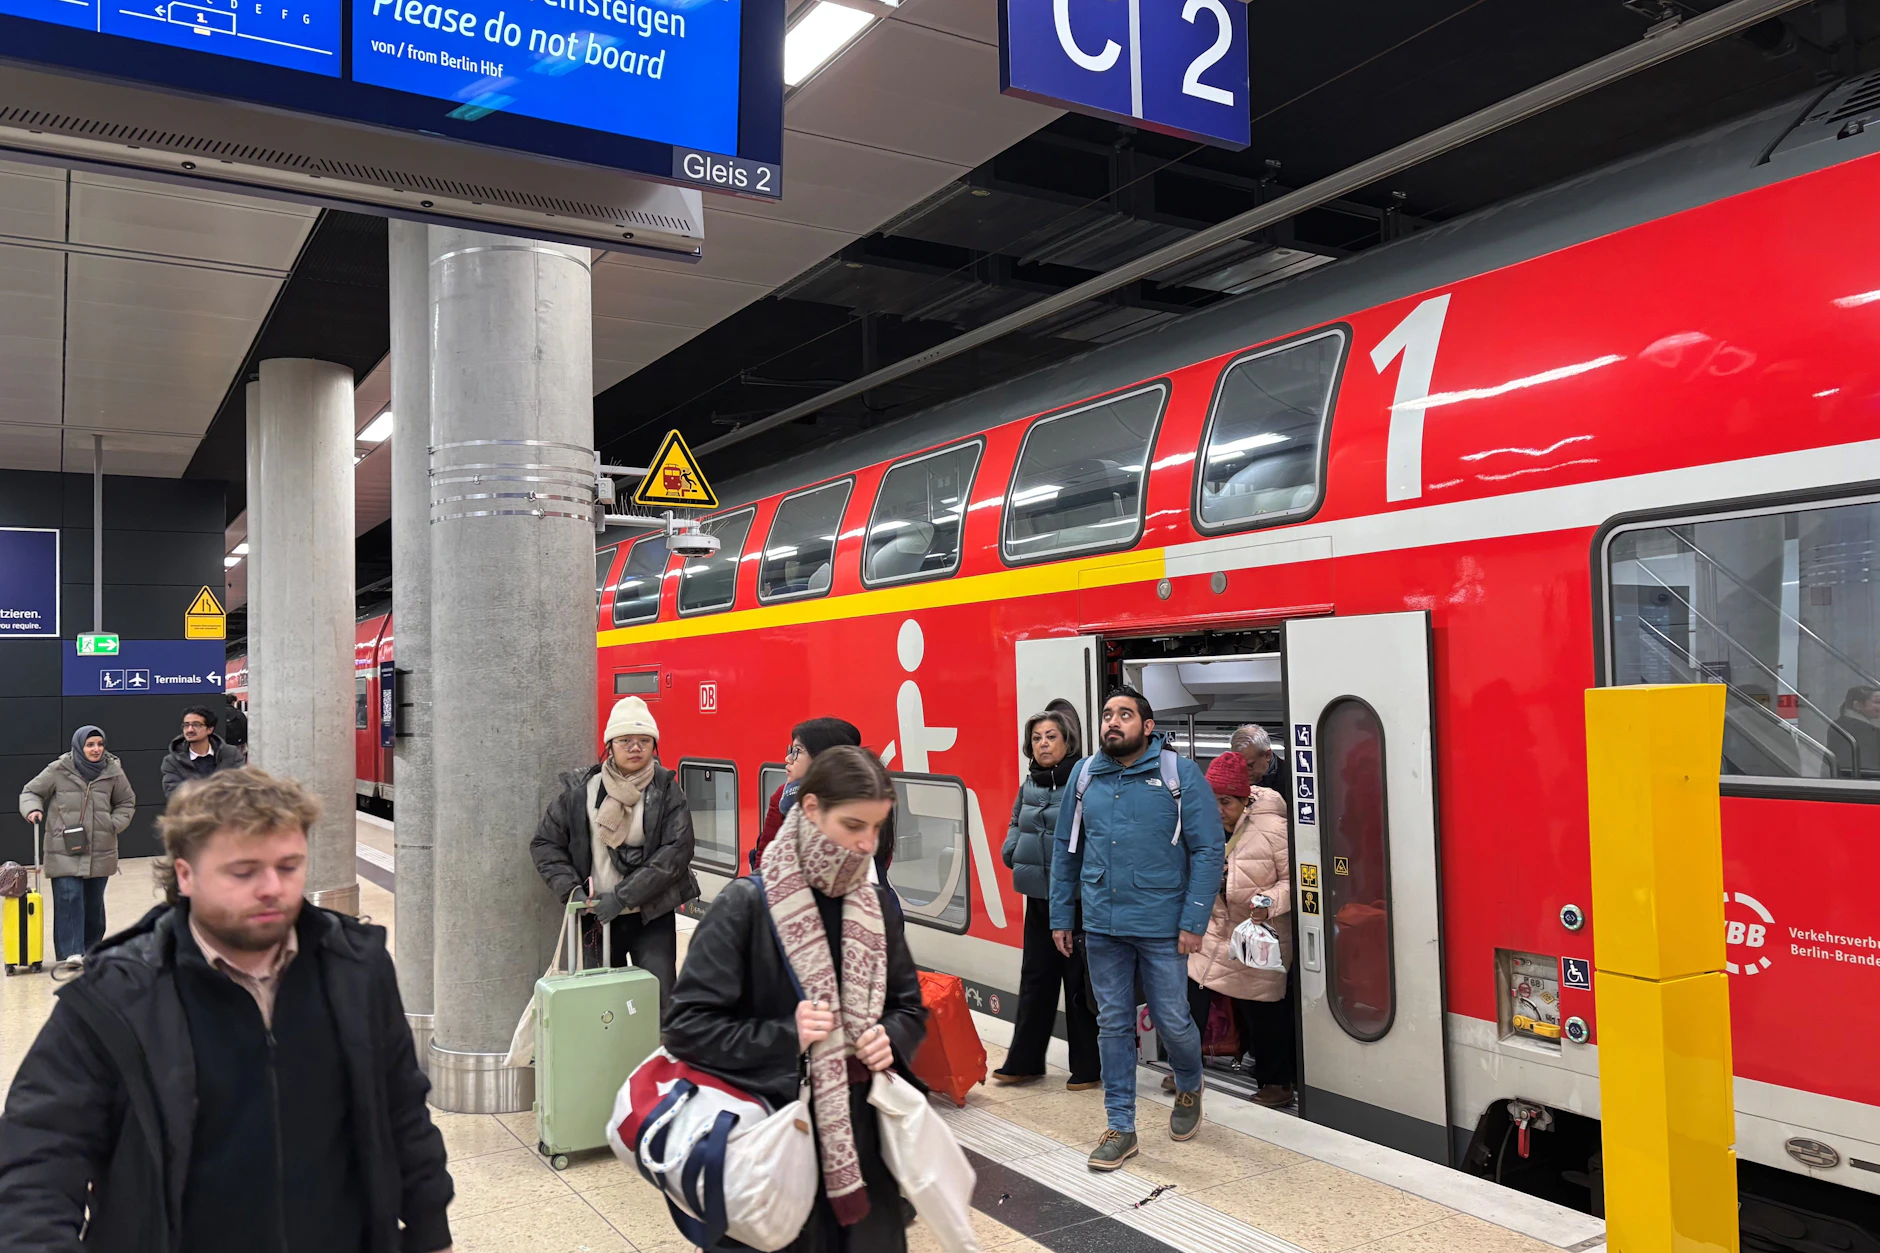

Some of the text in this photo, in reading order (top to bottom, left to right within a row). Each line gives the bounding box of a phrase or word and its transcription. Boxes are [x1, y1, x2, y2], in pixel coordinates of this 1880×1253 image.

[230, 0, 310, 25] D E F G
[372, 0, 666, 80] Please do not board
[1053, 0, 1234, 107] C 2
[370, 40, 395, 56] von
[407, 44, 437, 65] from
[440, 51, 478, 73] Berlin
[480, 60, 504, 78] Hbf
[683, 153, 771, 192] Gleis 2
[1369, 292, 1452, 503] 1
[12, 622, 42, 631] require.
[154, 674, 202, 684] Terminals
[701, 686, 715, 708] DB
[1724, 920, 1767, 948] BB
